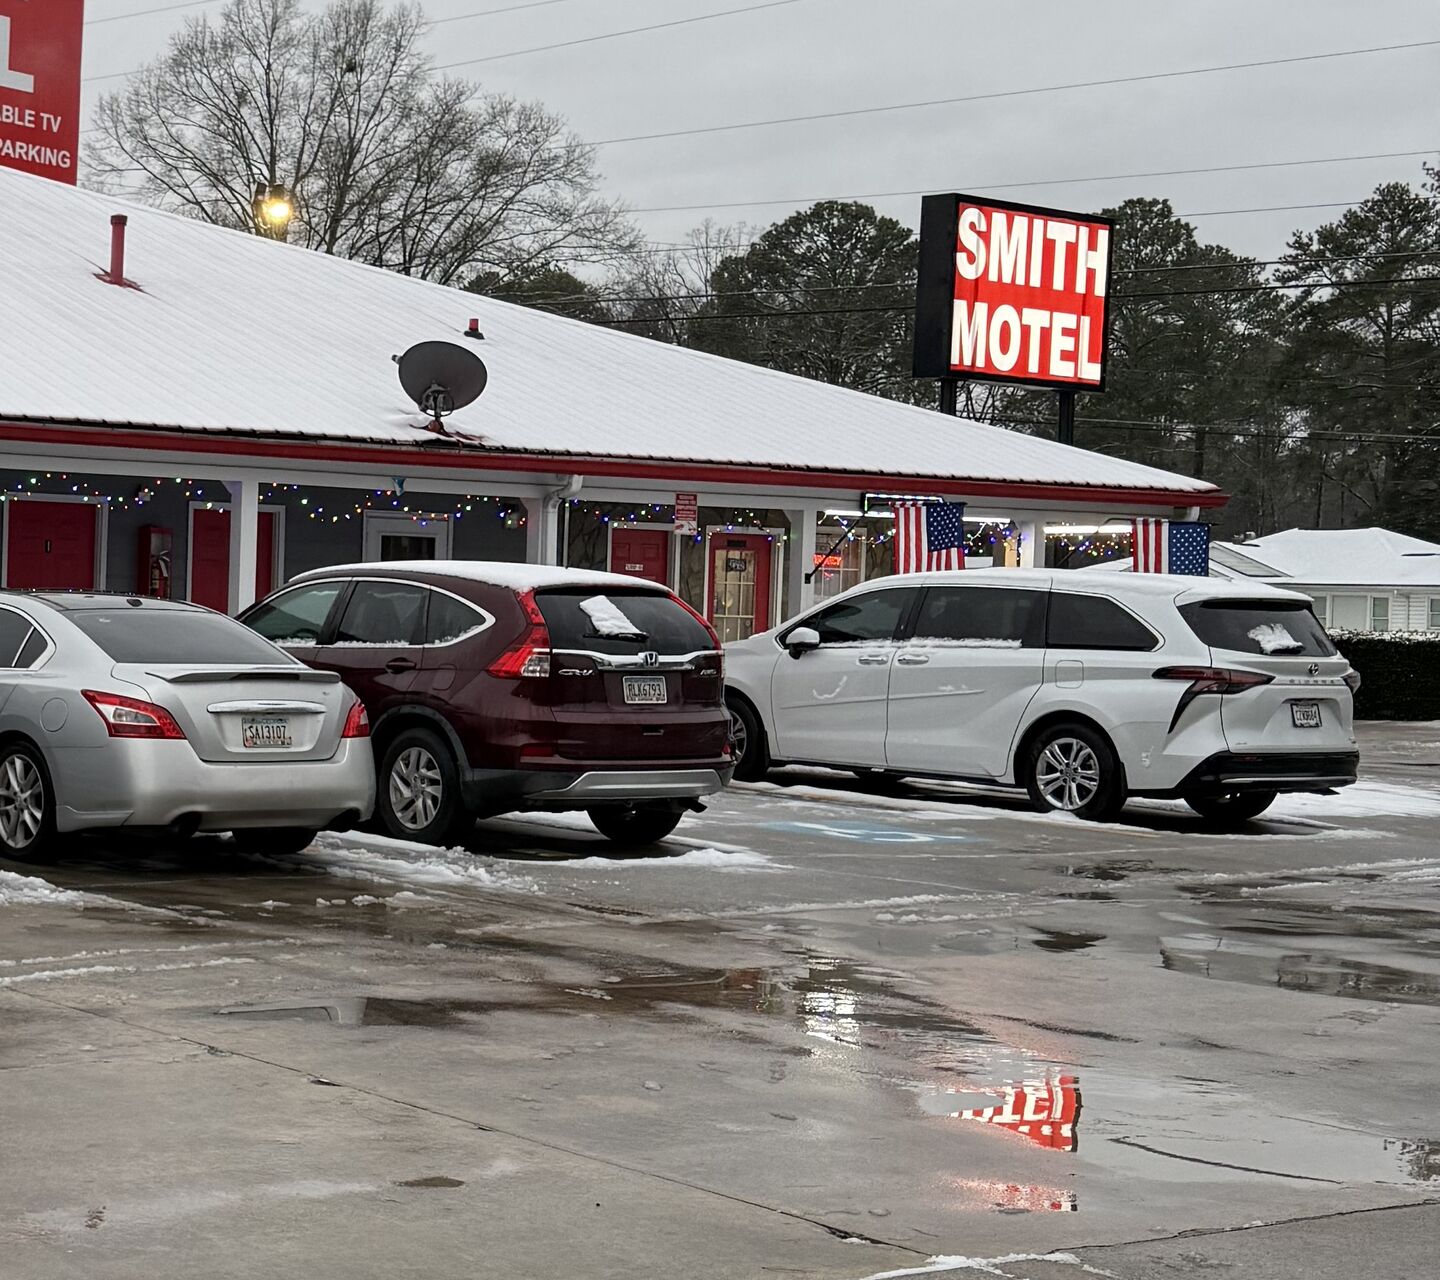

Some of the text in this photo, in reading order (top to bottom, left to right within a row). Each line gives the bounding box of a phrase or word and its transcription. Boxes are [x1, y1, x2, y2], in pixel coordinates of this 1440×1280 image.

[40, 112, 62, 133] TV
[955, 207, 1110, 297] SMITH
[950, 298, 1101, 381] MOTEL
